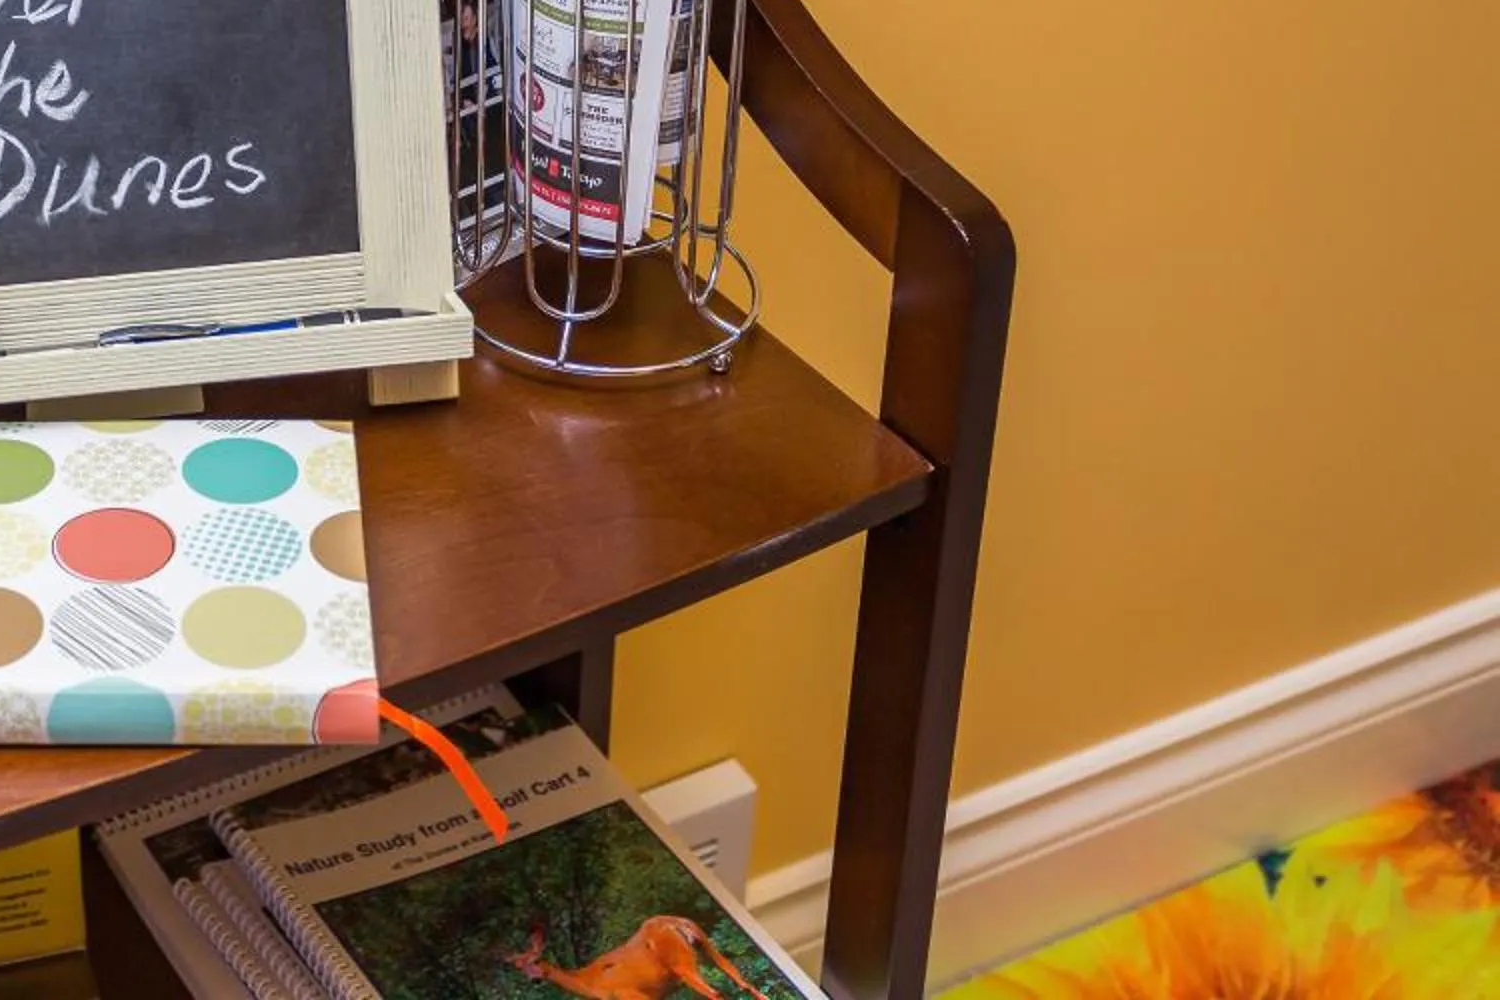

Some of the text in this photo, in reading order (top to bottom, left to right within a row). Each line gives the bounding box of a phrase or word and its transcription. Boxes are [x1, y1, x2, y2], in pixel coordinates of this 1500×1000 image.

[284, 850, 355, 878] Nature
[356, 832, 418, 859] Study
[417, 815, 469, 838] from
[493, 791, 530, 813] olf
[531, 772, 574, 797] Cart
[577, 765, 591, 780] 4
